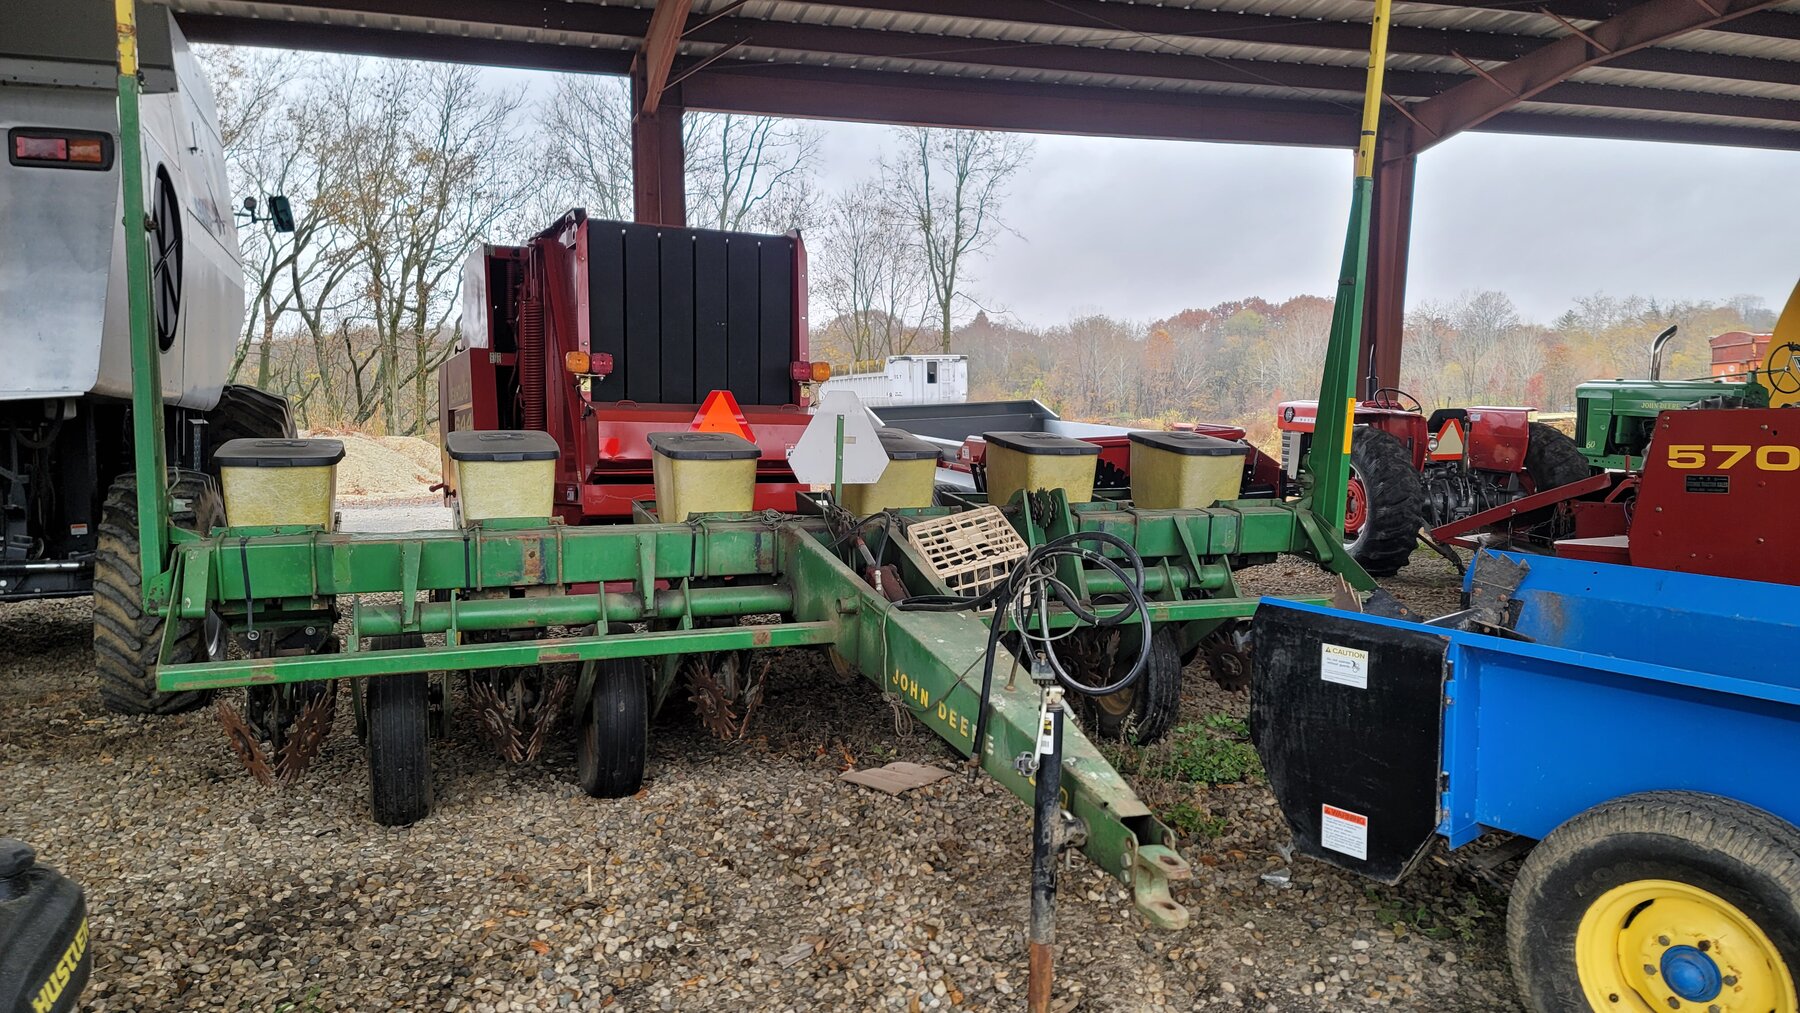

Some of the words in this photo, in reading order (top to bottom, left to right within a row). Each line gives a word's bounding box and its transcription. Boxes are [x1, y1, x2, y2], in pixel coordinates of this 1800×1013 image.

[1641, 401, 1658, 409] JOHN
[1660, 402, 1681, 410] DEERE
[1585, 440, 1596, 450] 60
[1667, 444, 1800, 471] 570
[1332, 647, 1366, 659] CAUTION
[892, 669, 929, 709] JOHN
[938, 701, 995, 756] DEEE
